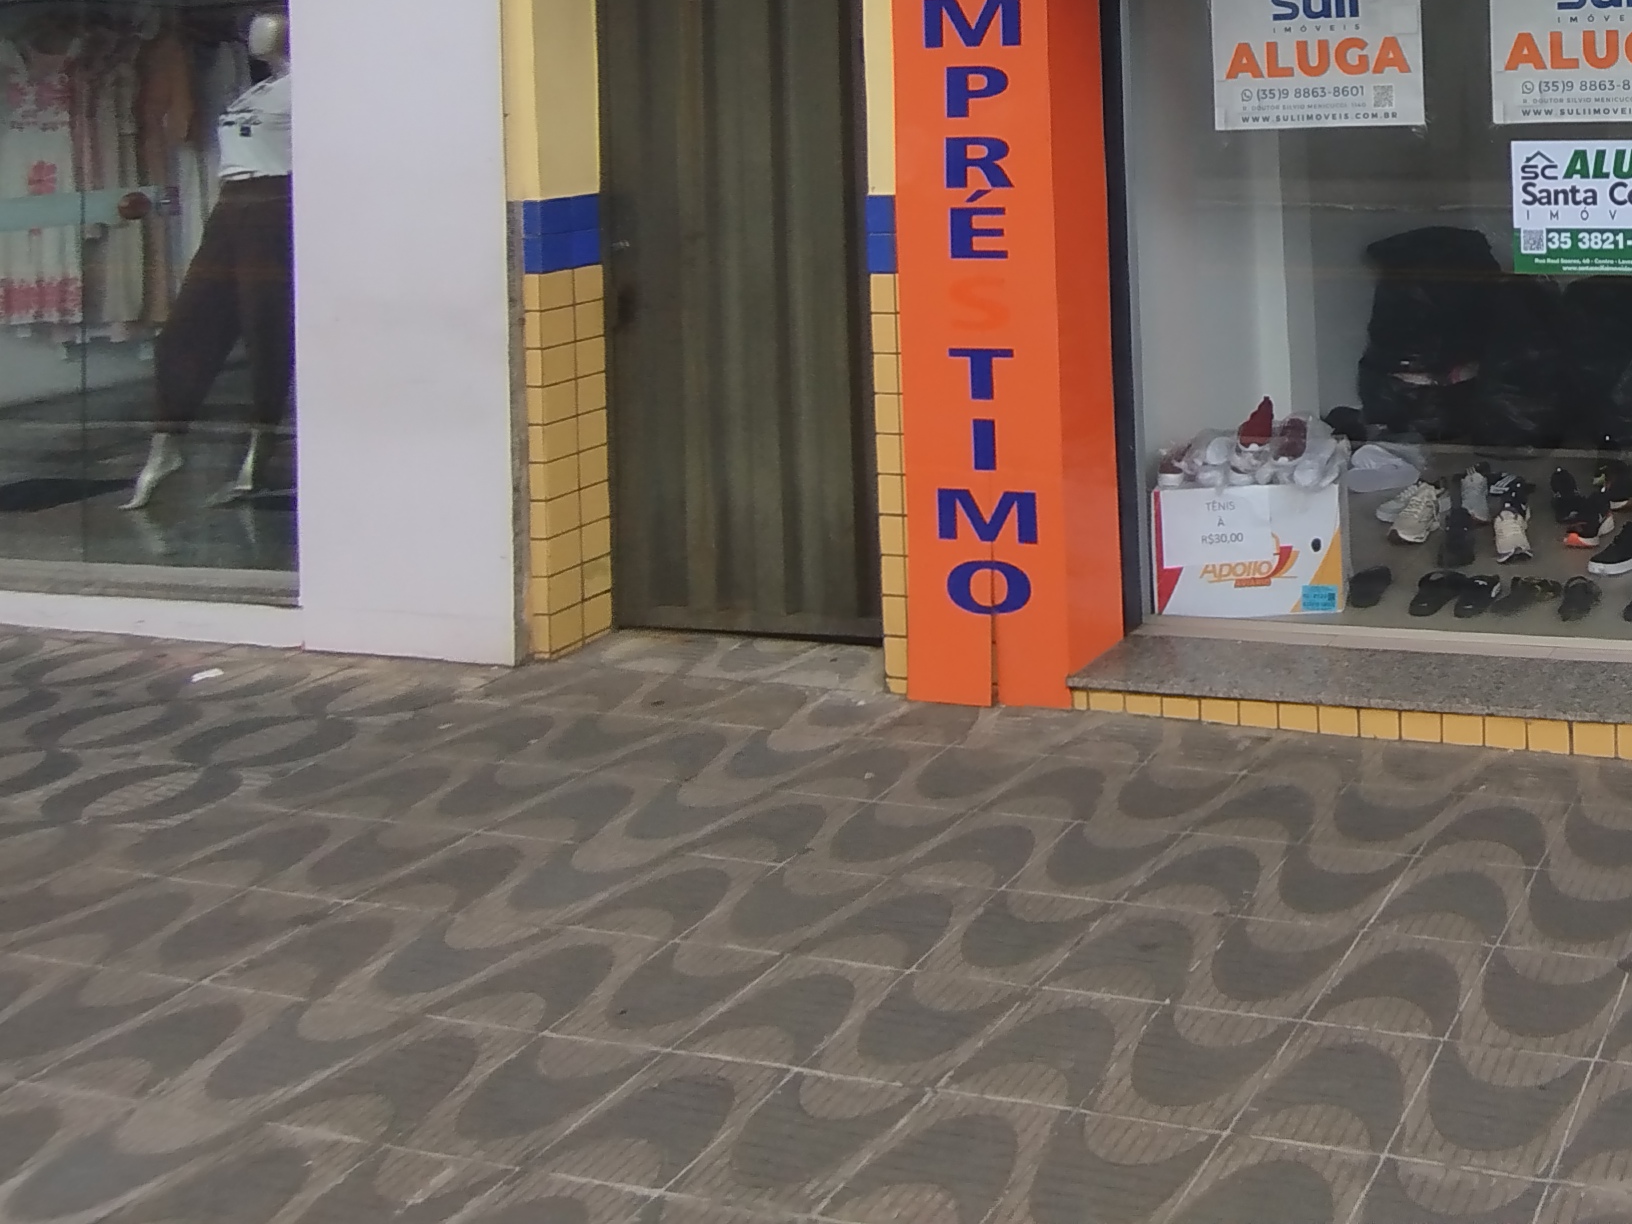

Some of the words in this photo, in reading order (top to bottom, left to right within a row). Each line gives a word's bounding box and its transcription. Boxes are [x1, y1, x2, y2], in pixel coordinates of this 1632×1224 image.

[1273, 23, 1360, 34] IMÓVEIS
[1225, 36, 1412, 80] ALUGA
[1256, 88, 1290, 102] (35)9
[1294, 85, 1365, 99] 8863-8601
[1538, 80, 1575, 94] (35)9
[1521, 181, 1598, 206] Santa
[1547, 232, 1572, 250] 35
[1205, 500, 1236, 512] TÊNIS
[1201, 532, 1244, 545] R$30,00
